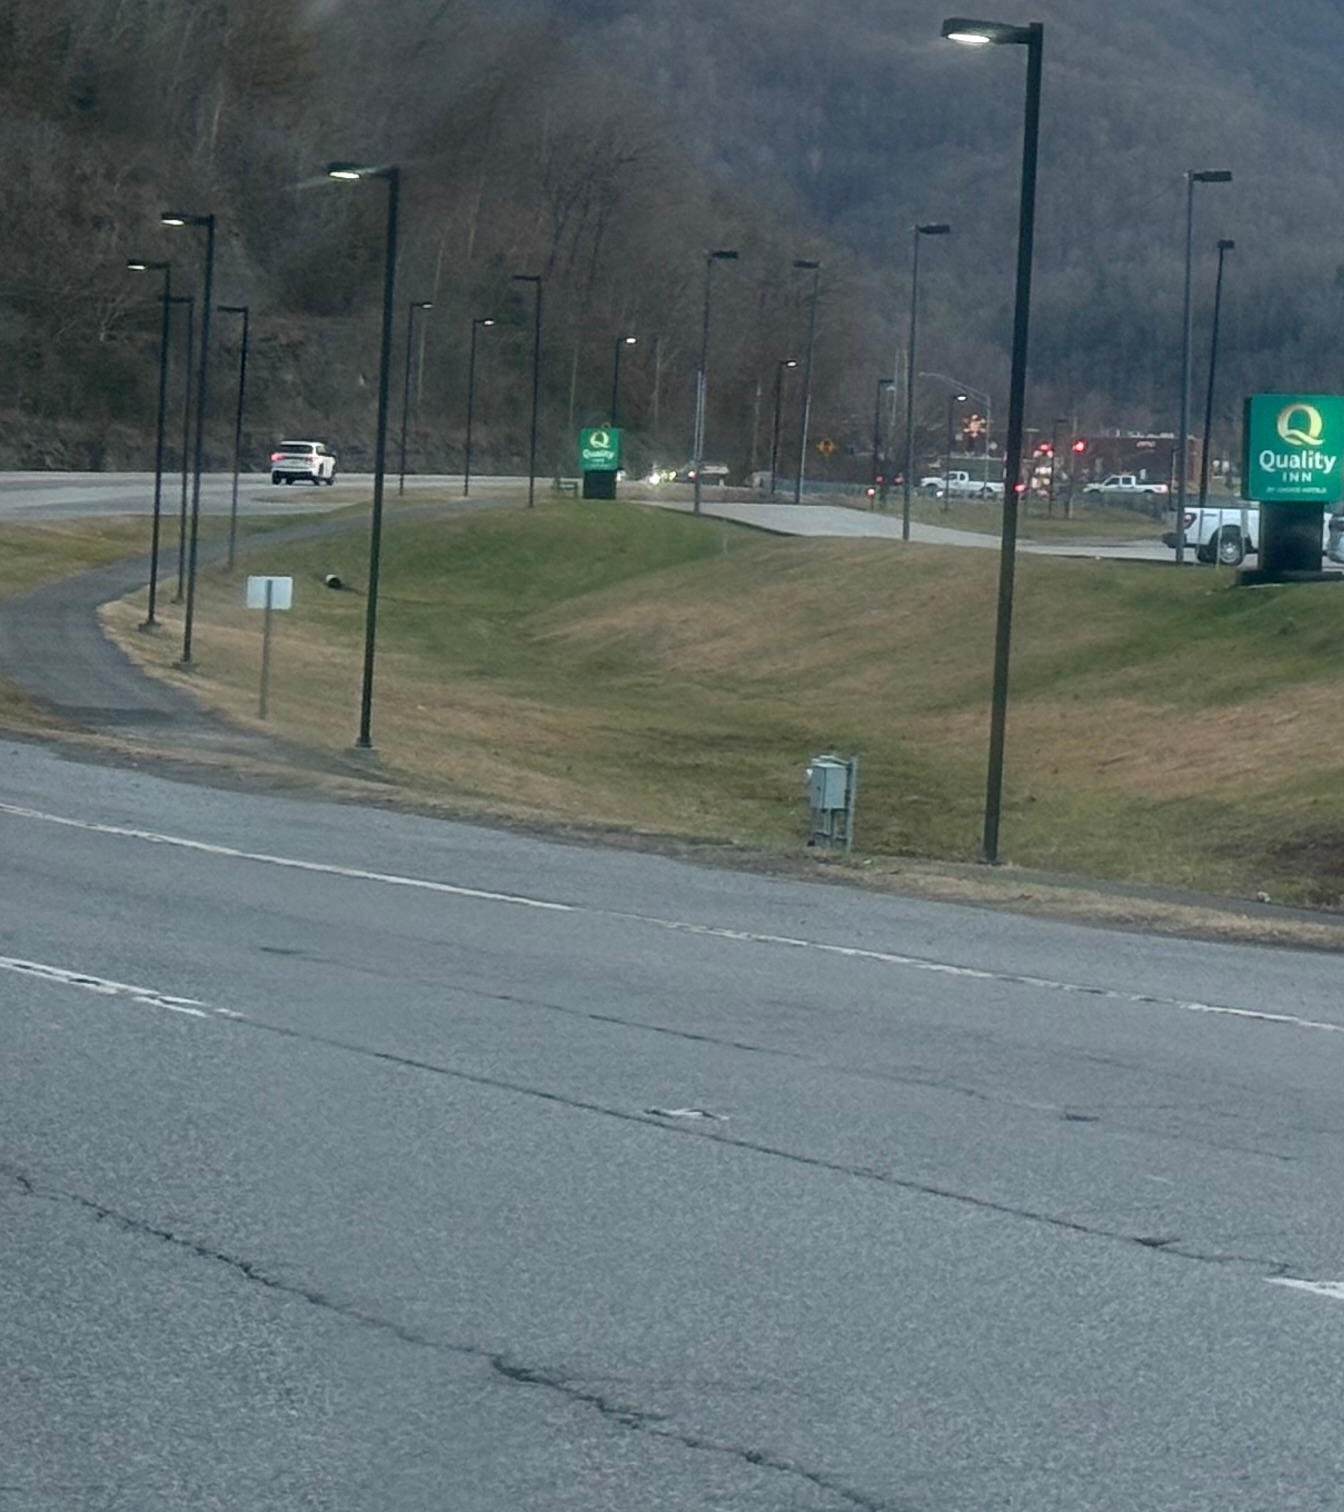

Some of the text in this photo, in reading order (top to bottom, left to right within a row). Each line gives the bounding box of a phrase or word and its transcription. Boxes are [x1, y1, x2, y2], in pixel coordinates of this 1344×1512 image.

[1277, 403, 1325, 445] Q
[1259, 450, 1336, 474] Quality
[1282, 471, 1312, 483] INN
